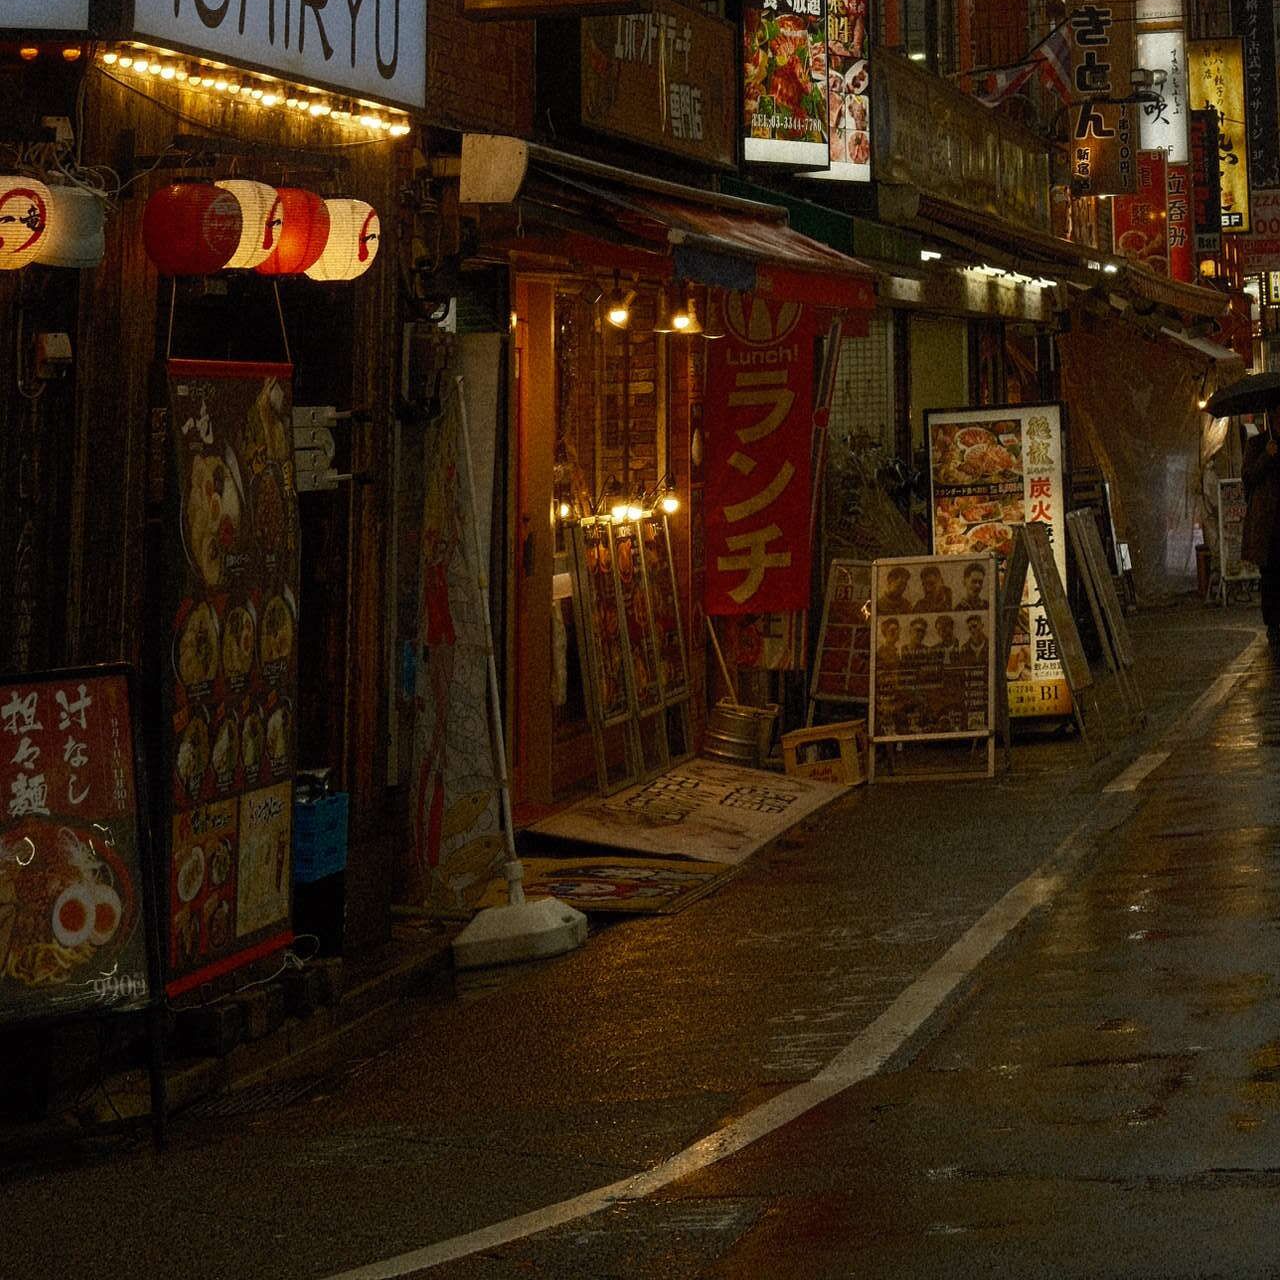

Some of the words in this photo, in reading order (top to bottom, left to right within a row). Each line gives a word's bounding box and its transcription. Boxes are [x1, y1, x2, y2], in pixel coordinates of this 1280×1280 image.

[726, 344, 798, 367] Lunch!
[717, 371, 796, 605] ランチ
[55, 686, 92, 806] 汁なし
